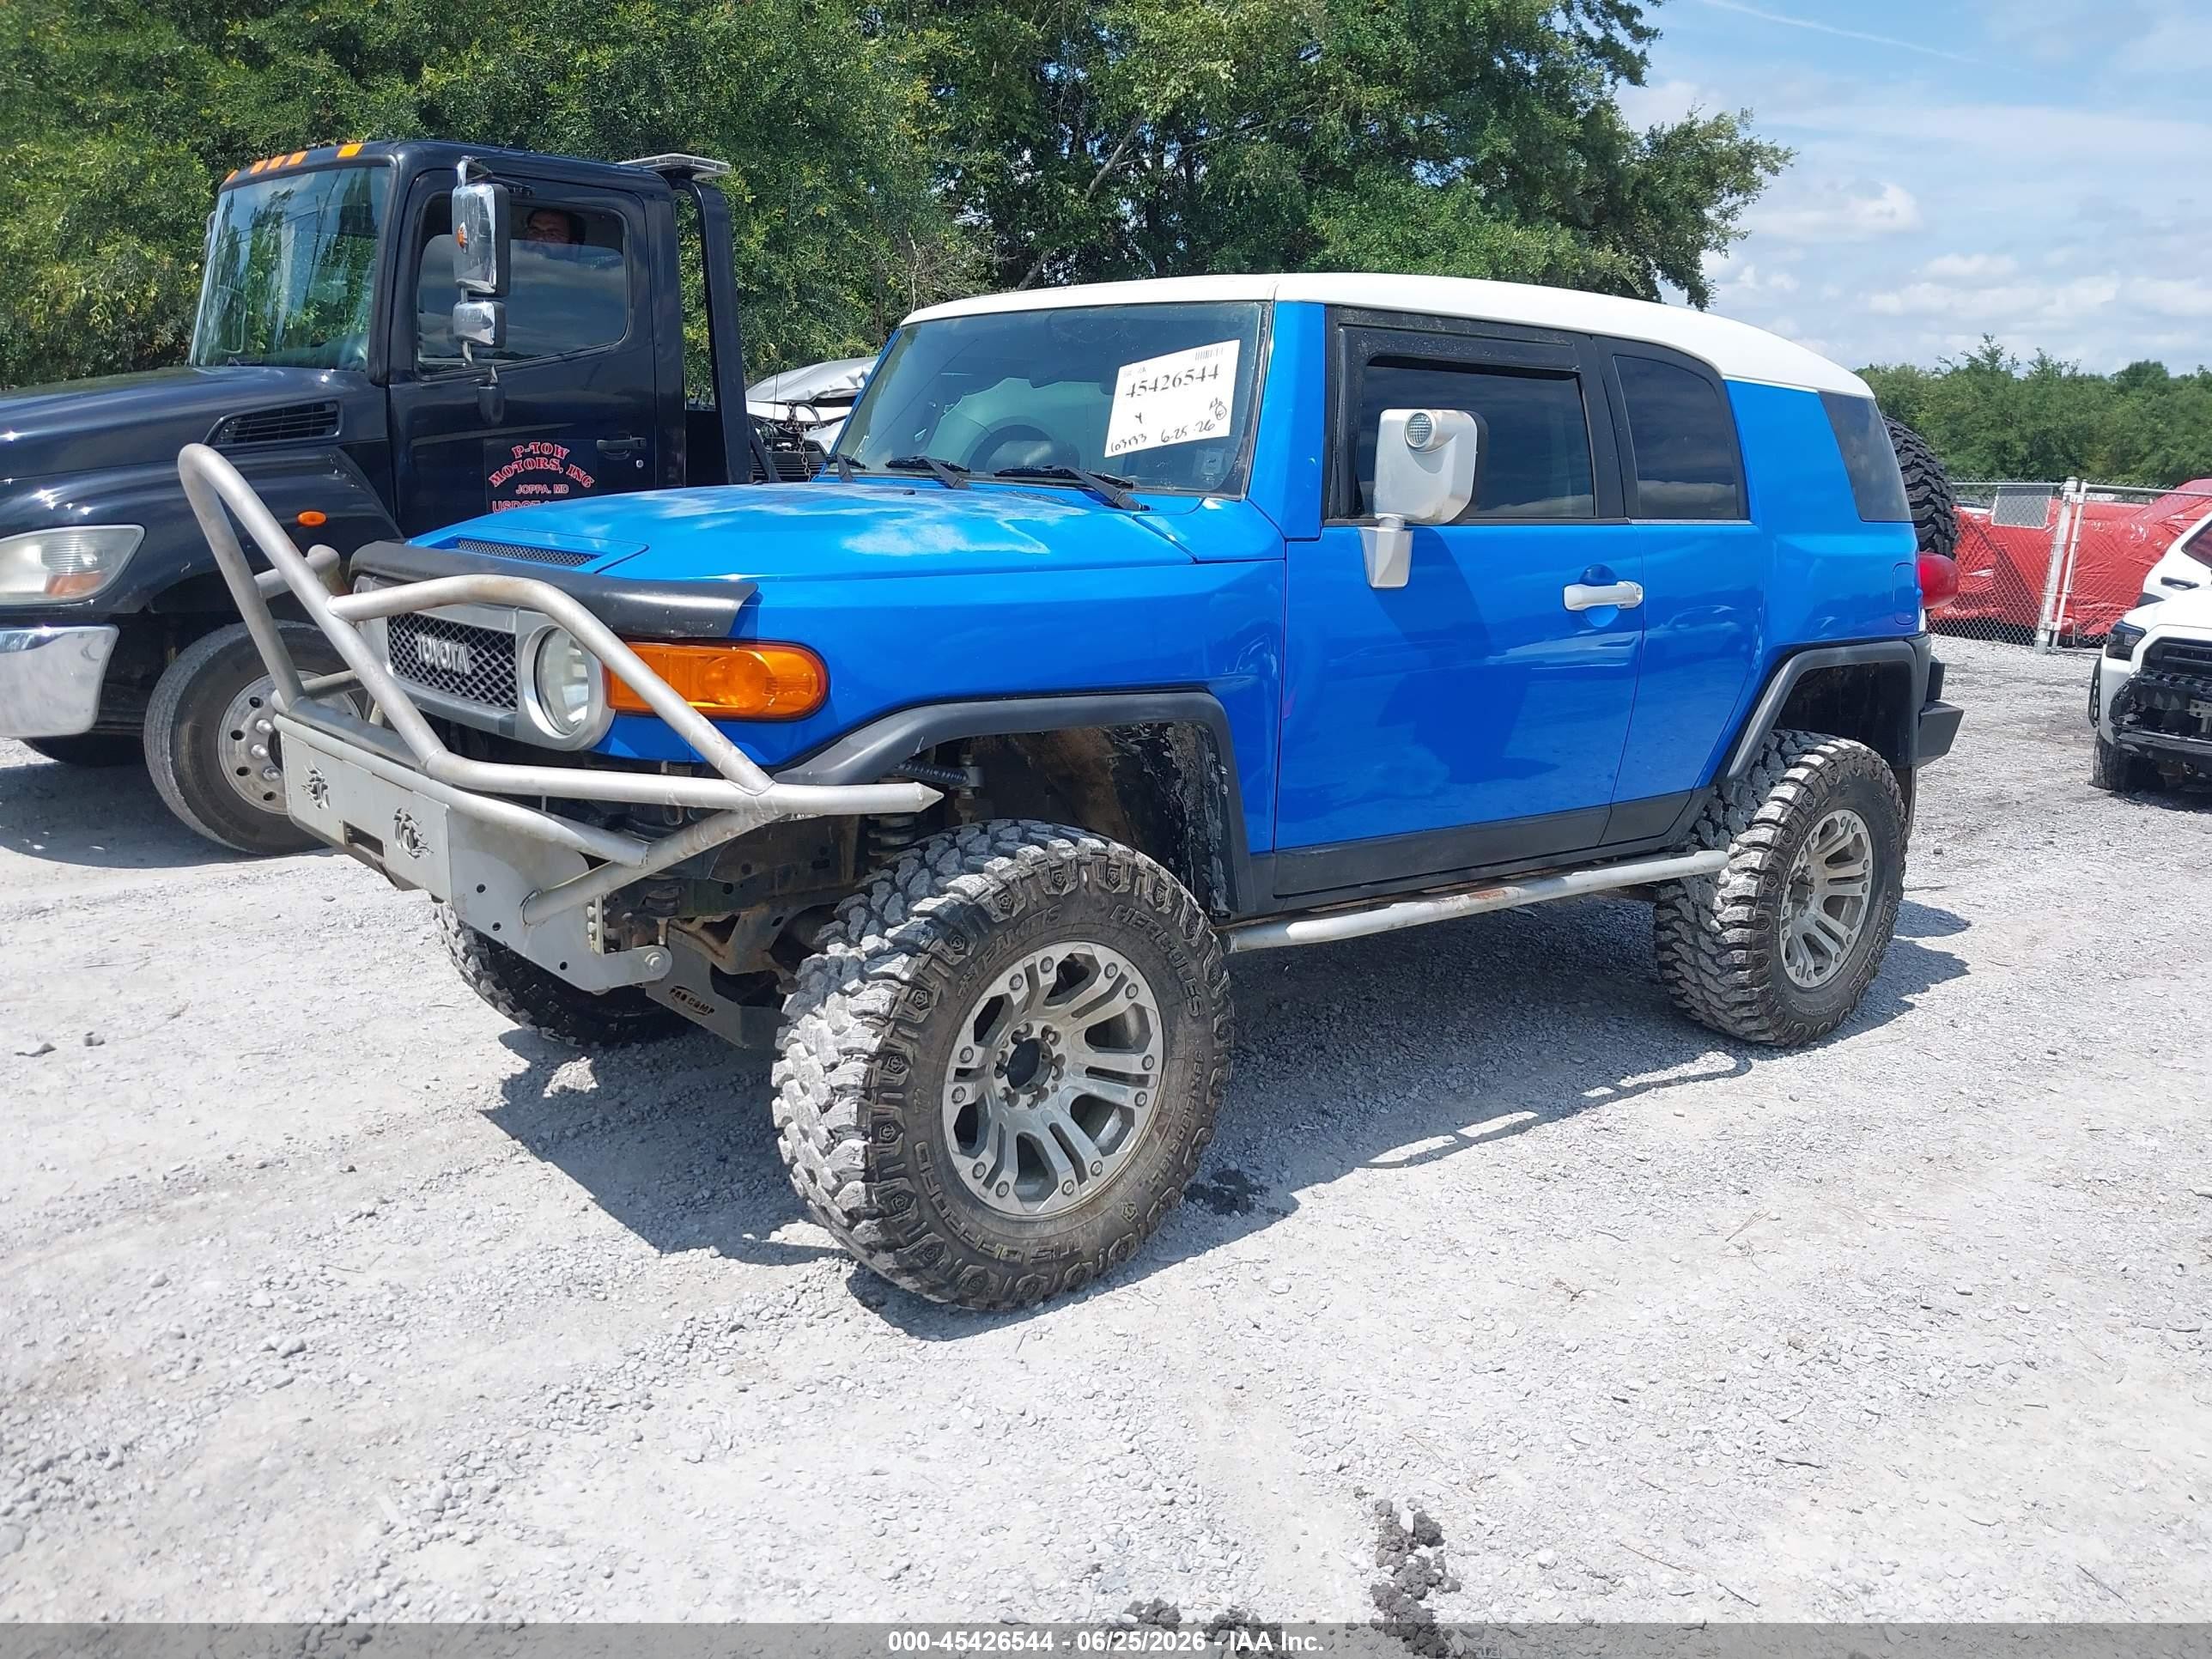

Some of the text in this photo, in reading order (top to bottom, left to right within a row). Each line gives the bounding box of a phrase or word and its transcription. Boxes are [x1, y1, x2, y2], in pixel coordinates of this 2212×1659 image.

[1126, 364, 1218, 398] 45426544
[511, 442, 570, 459] P-TOW
[488, 457, 564, 488] MOTORS,
[553, 483, 569, 495] MD
[417, 634, 471, 675] TOYOTA
[1109, 904, 1201, 1018] HERCULES
